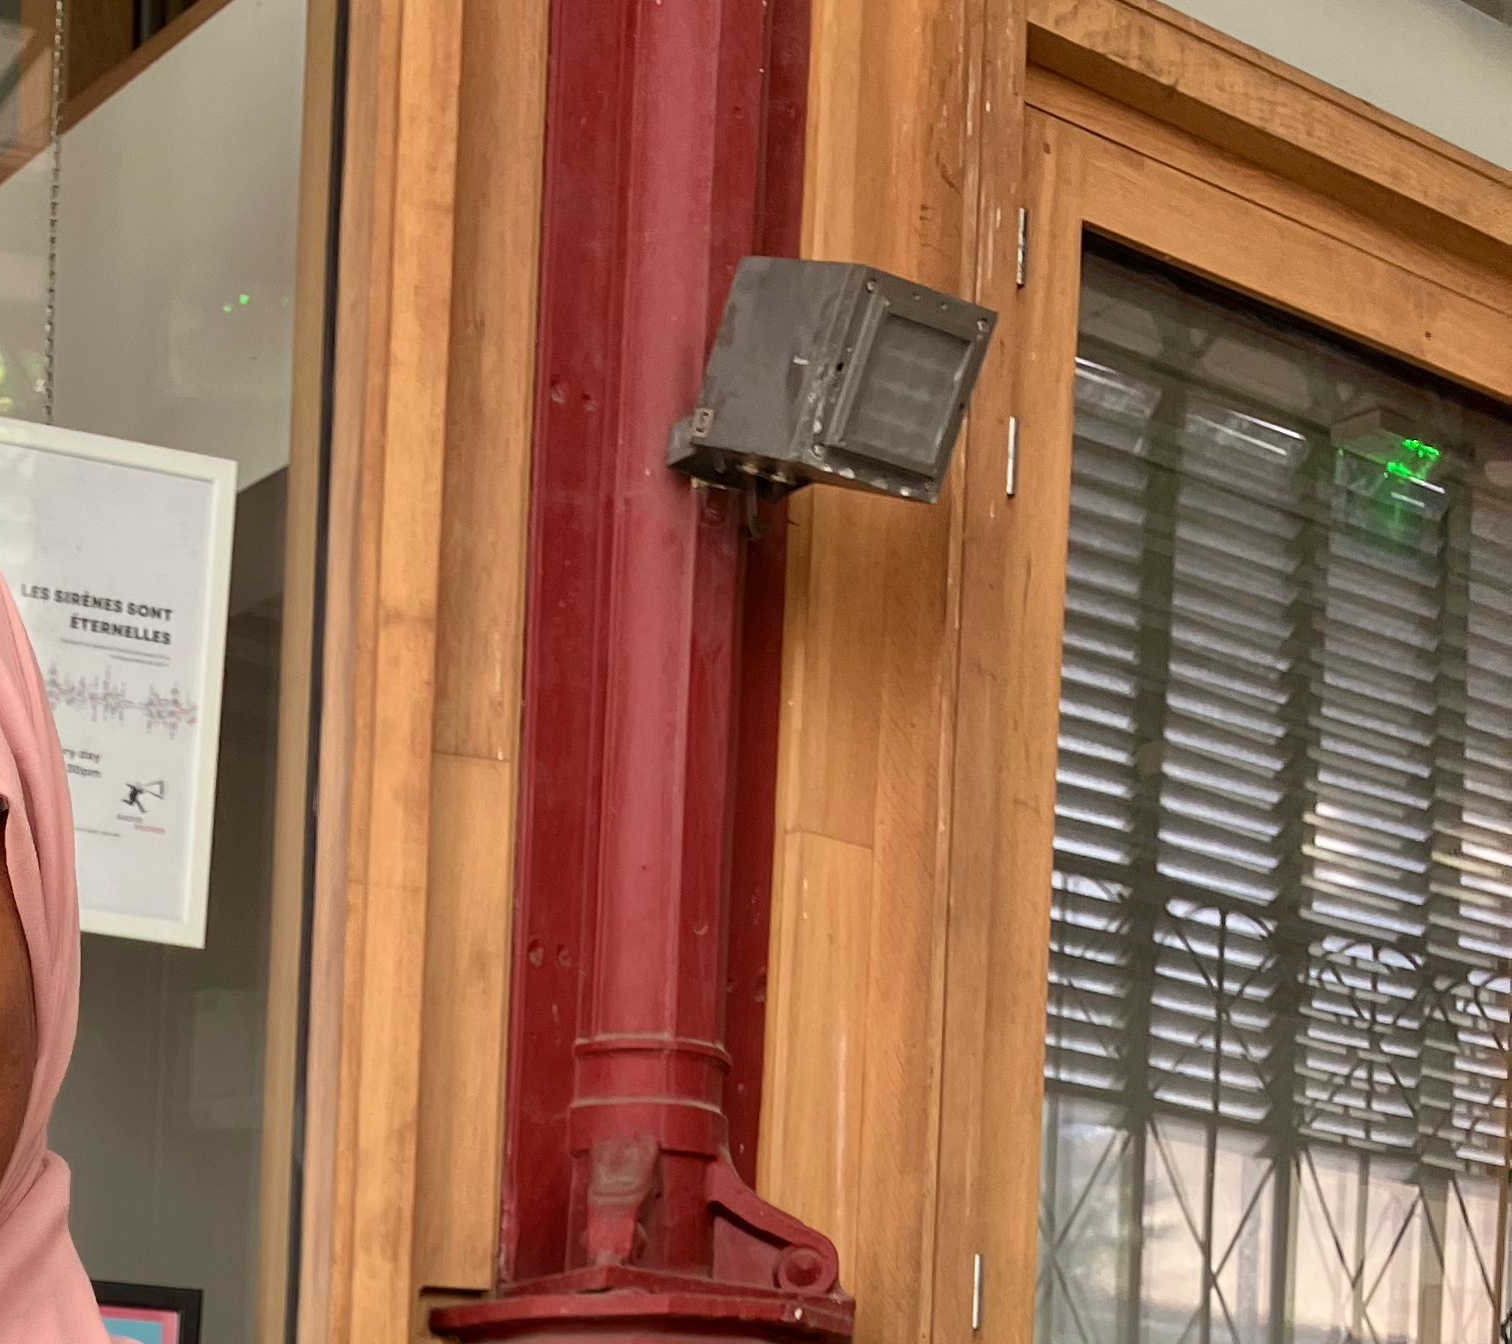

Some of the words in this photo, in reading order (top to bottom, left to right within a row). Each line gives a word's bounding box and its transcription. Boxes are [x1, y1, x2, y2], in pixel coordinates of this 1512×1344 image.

[21, 583, 50, 600] LES
[54, 589, 123, 613] SIRÈNES
[127, 602, 173, 622] SONT
[70, 612, 172, 645] ÉTERNELLES
